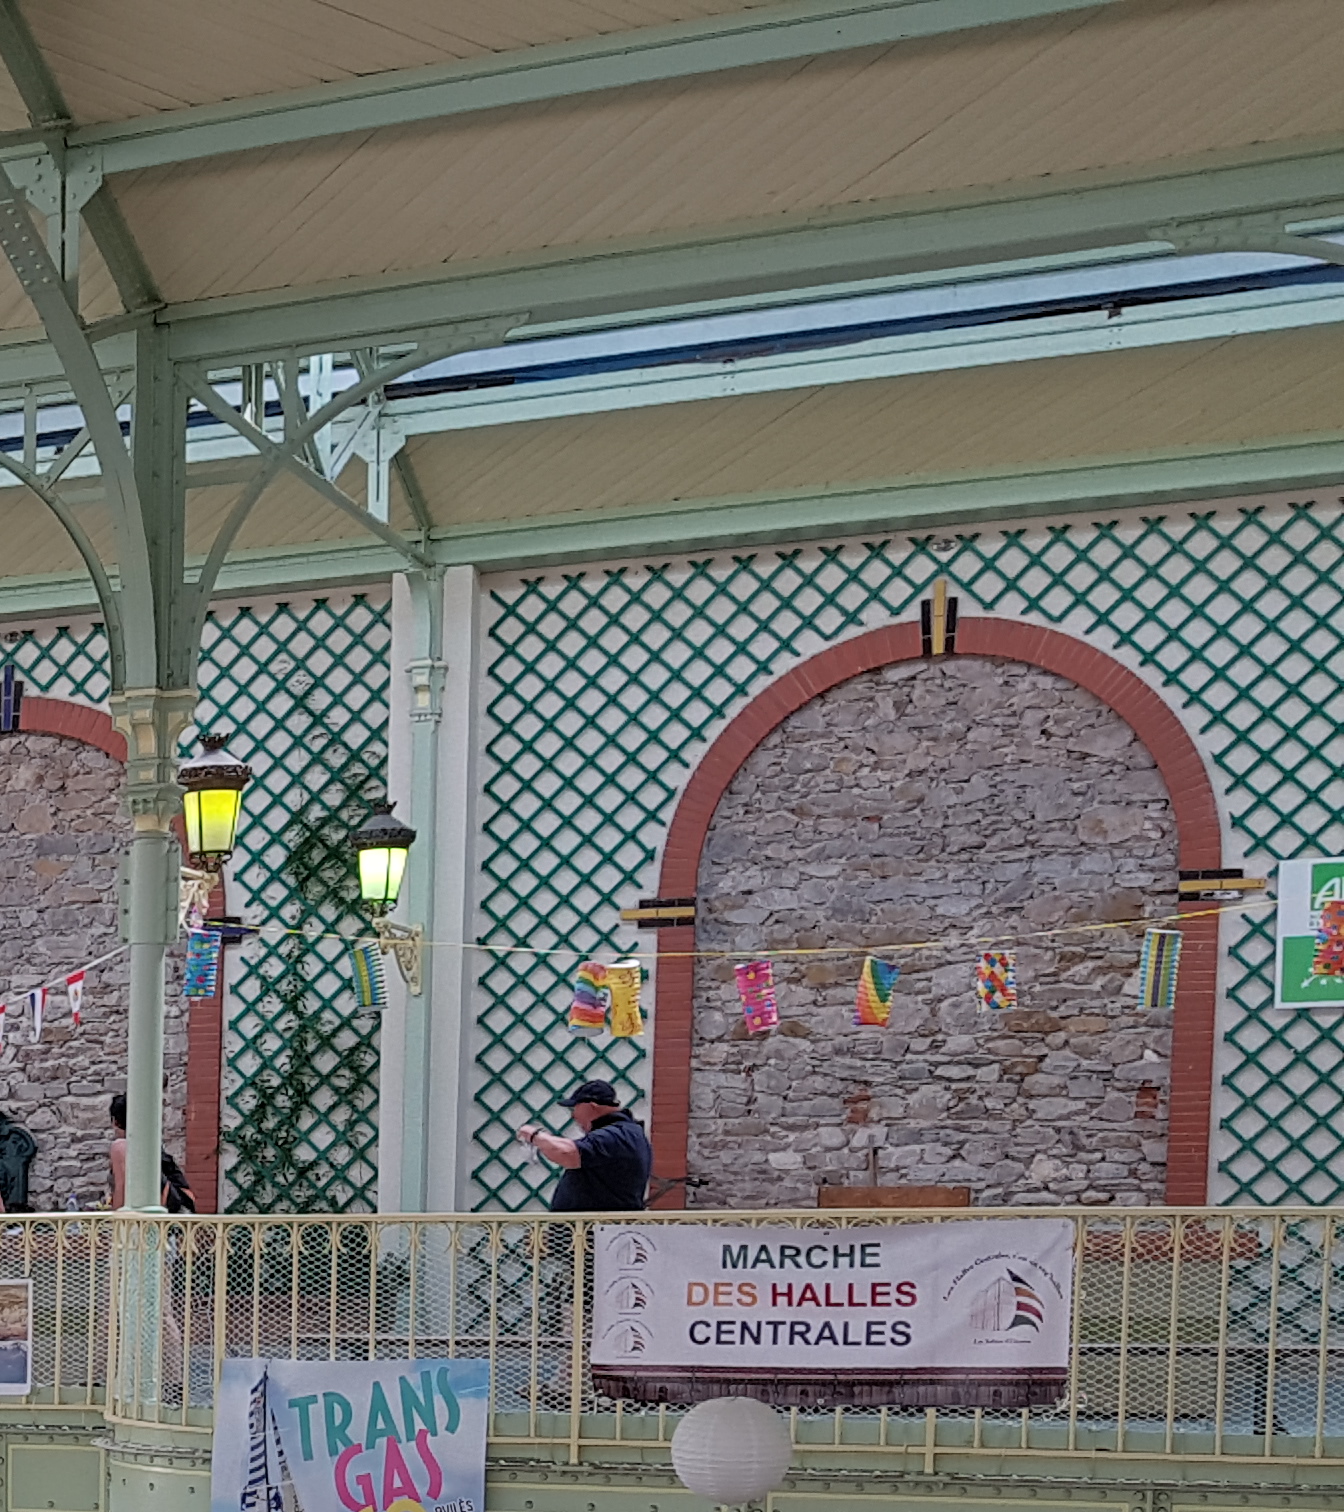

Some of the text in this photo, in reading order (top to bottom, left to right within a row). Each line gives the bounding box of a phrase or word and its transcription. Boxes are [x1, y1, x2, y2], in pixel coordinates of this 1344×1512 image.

[1314, 877, 1344, 910] A
[721, 1243, 881, 1269] MARCHE
[687, 1281, 917, 1307] DES HALLES
[689, 1320, 912, 1346] CENTRALES
[288, 1367, 461, 1462] TRANS
[334, 1428, 443, 1512] GAS
